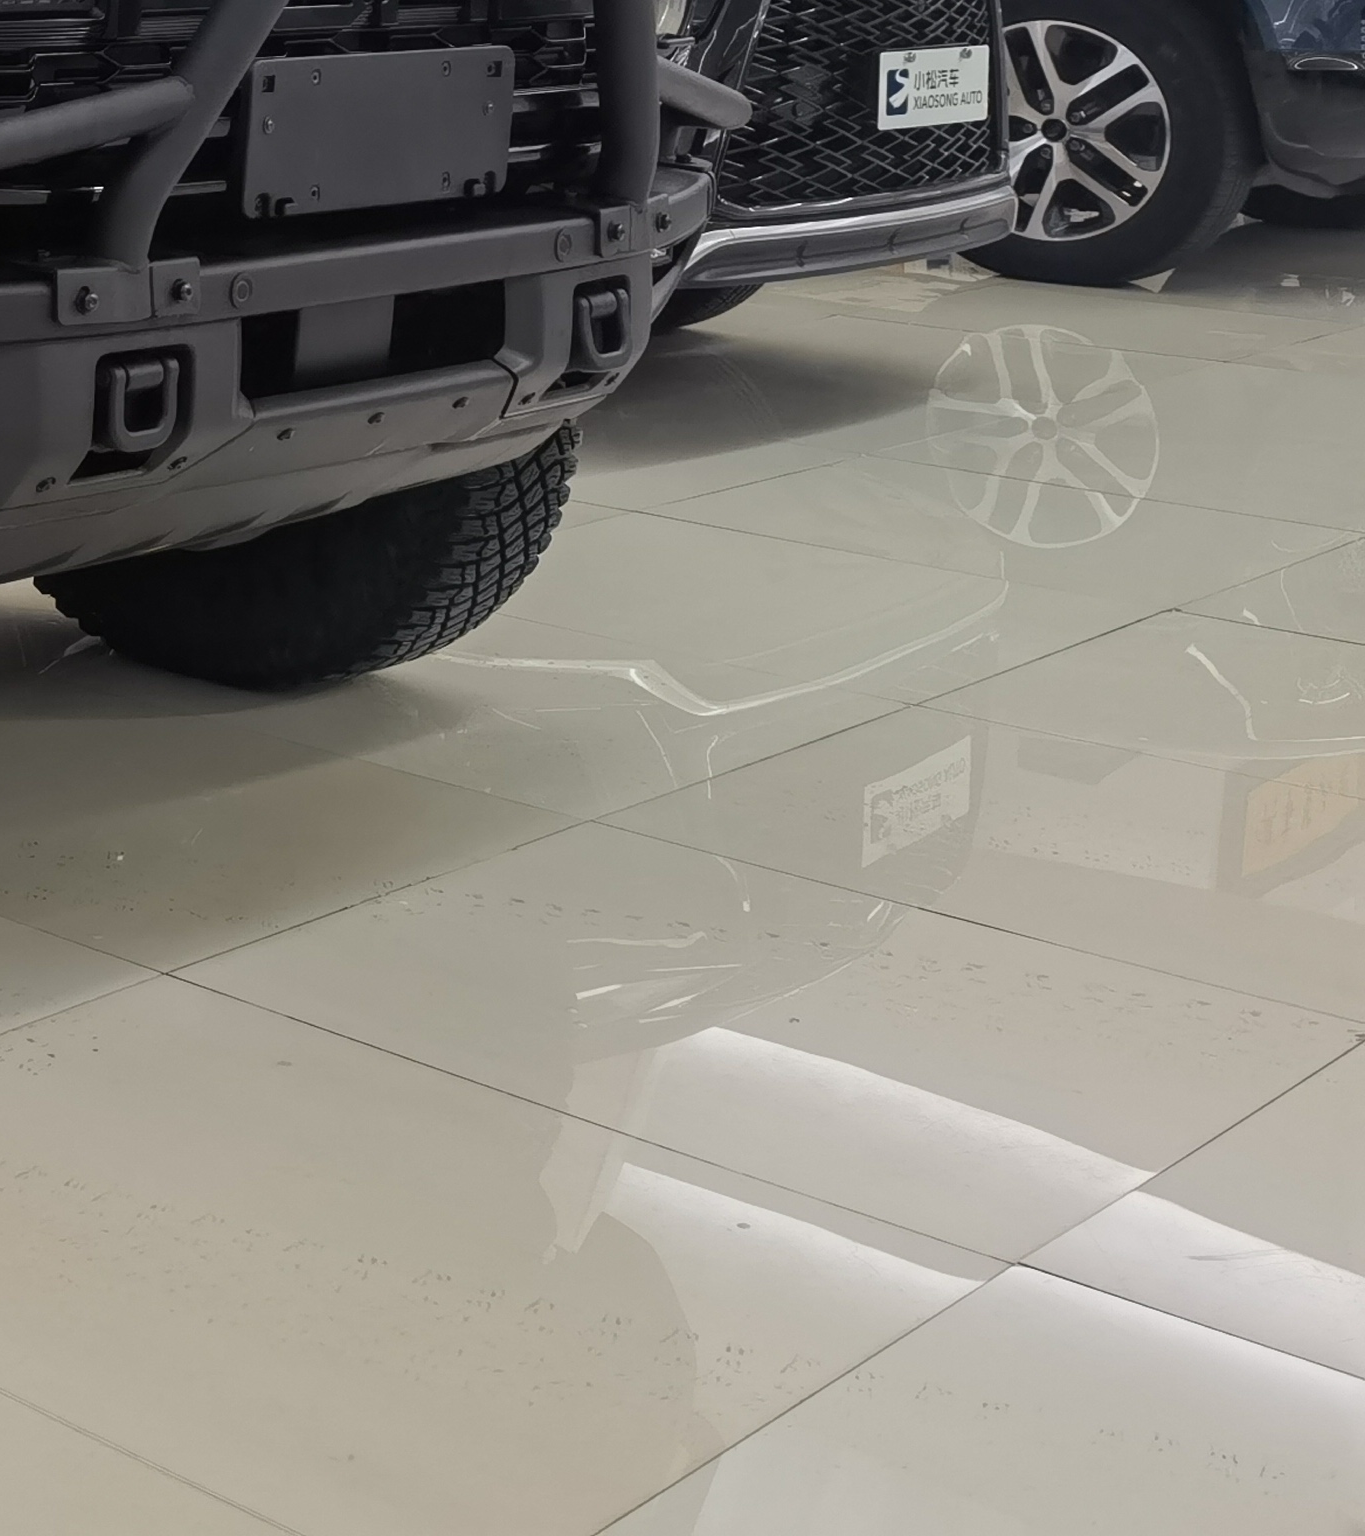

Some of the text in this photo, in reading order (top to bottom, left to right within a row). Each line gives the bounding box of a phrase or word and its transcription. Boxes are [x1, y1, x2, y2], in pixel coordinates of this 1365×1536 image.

[914, 69, 959, 90] 小松汽车
[913, 90, 983, 110] XIAOSONG AUTO
